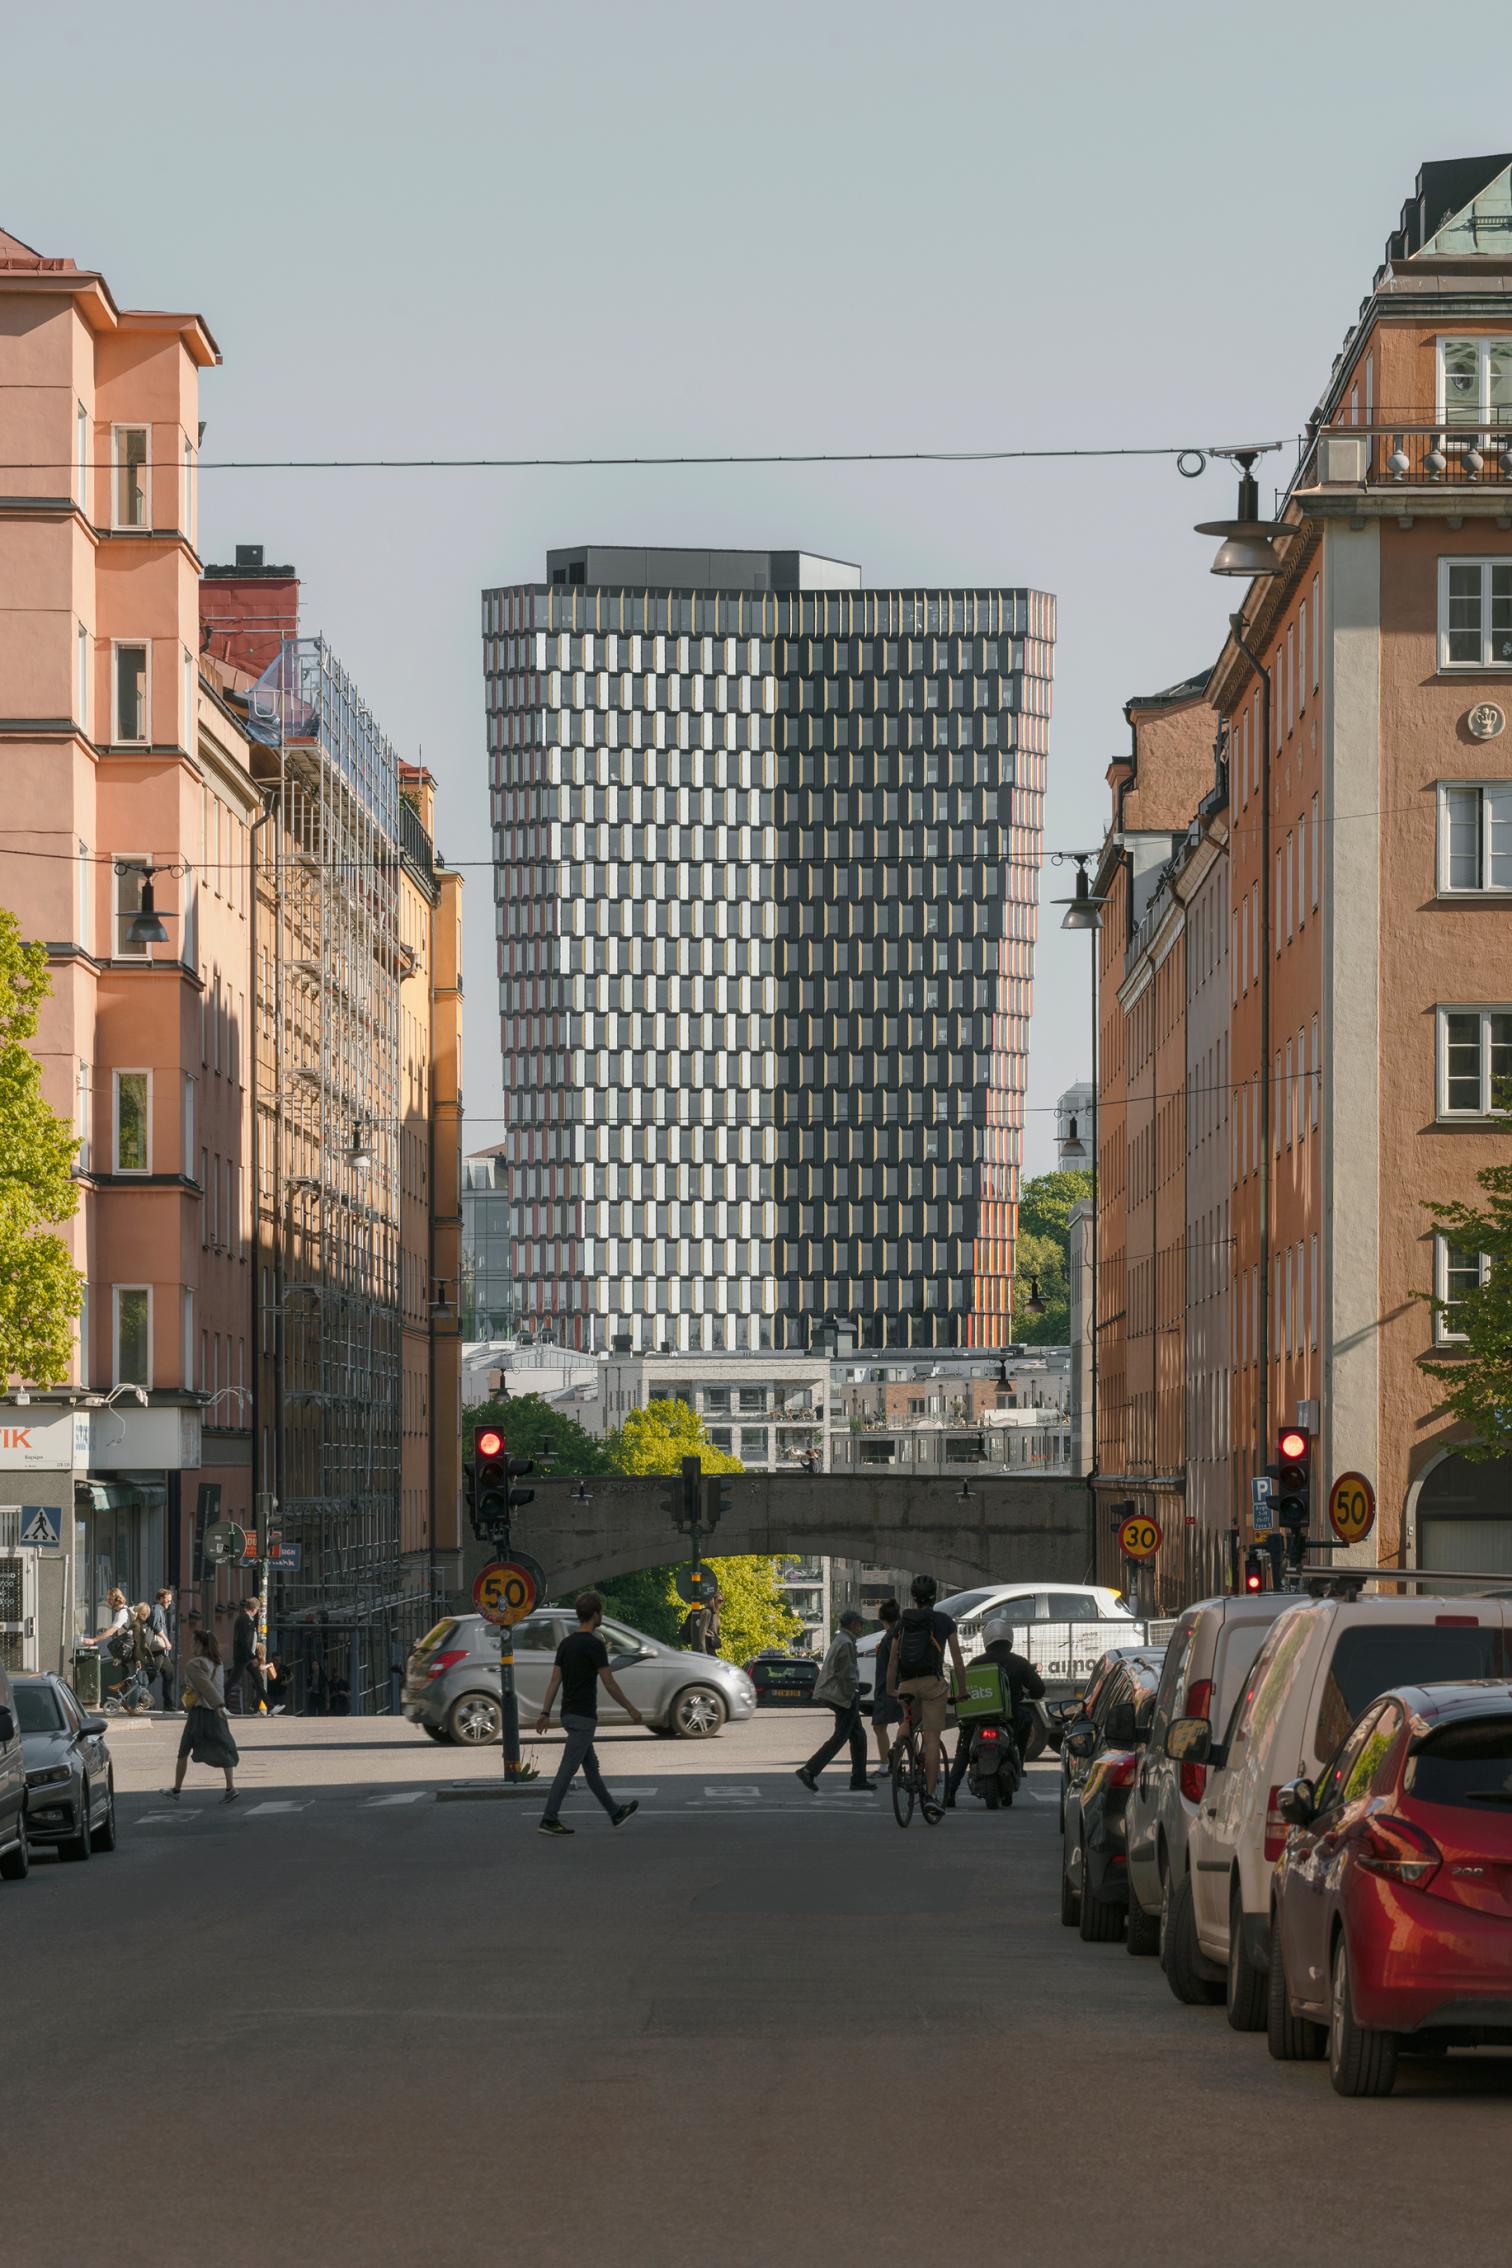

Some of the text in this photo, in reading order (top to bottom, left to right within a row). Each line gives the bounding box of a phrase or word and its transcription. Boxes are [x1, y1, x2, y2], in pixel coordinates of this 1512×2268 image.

[0, 1429, 32, 1449] IK
[1257, 1480, 1268, 1501] P
[1337, 1491, 1366, 1525] 50
[1126, 1526, 1156, 1549] 30
[485, 1578, 526, 1608] 50
[967, 1687, 993, 1700] ats
